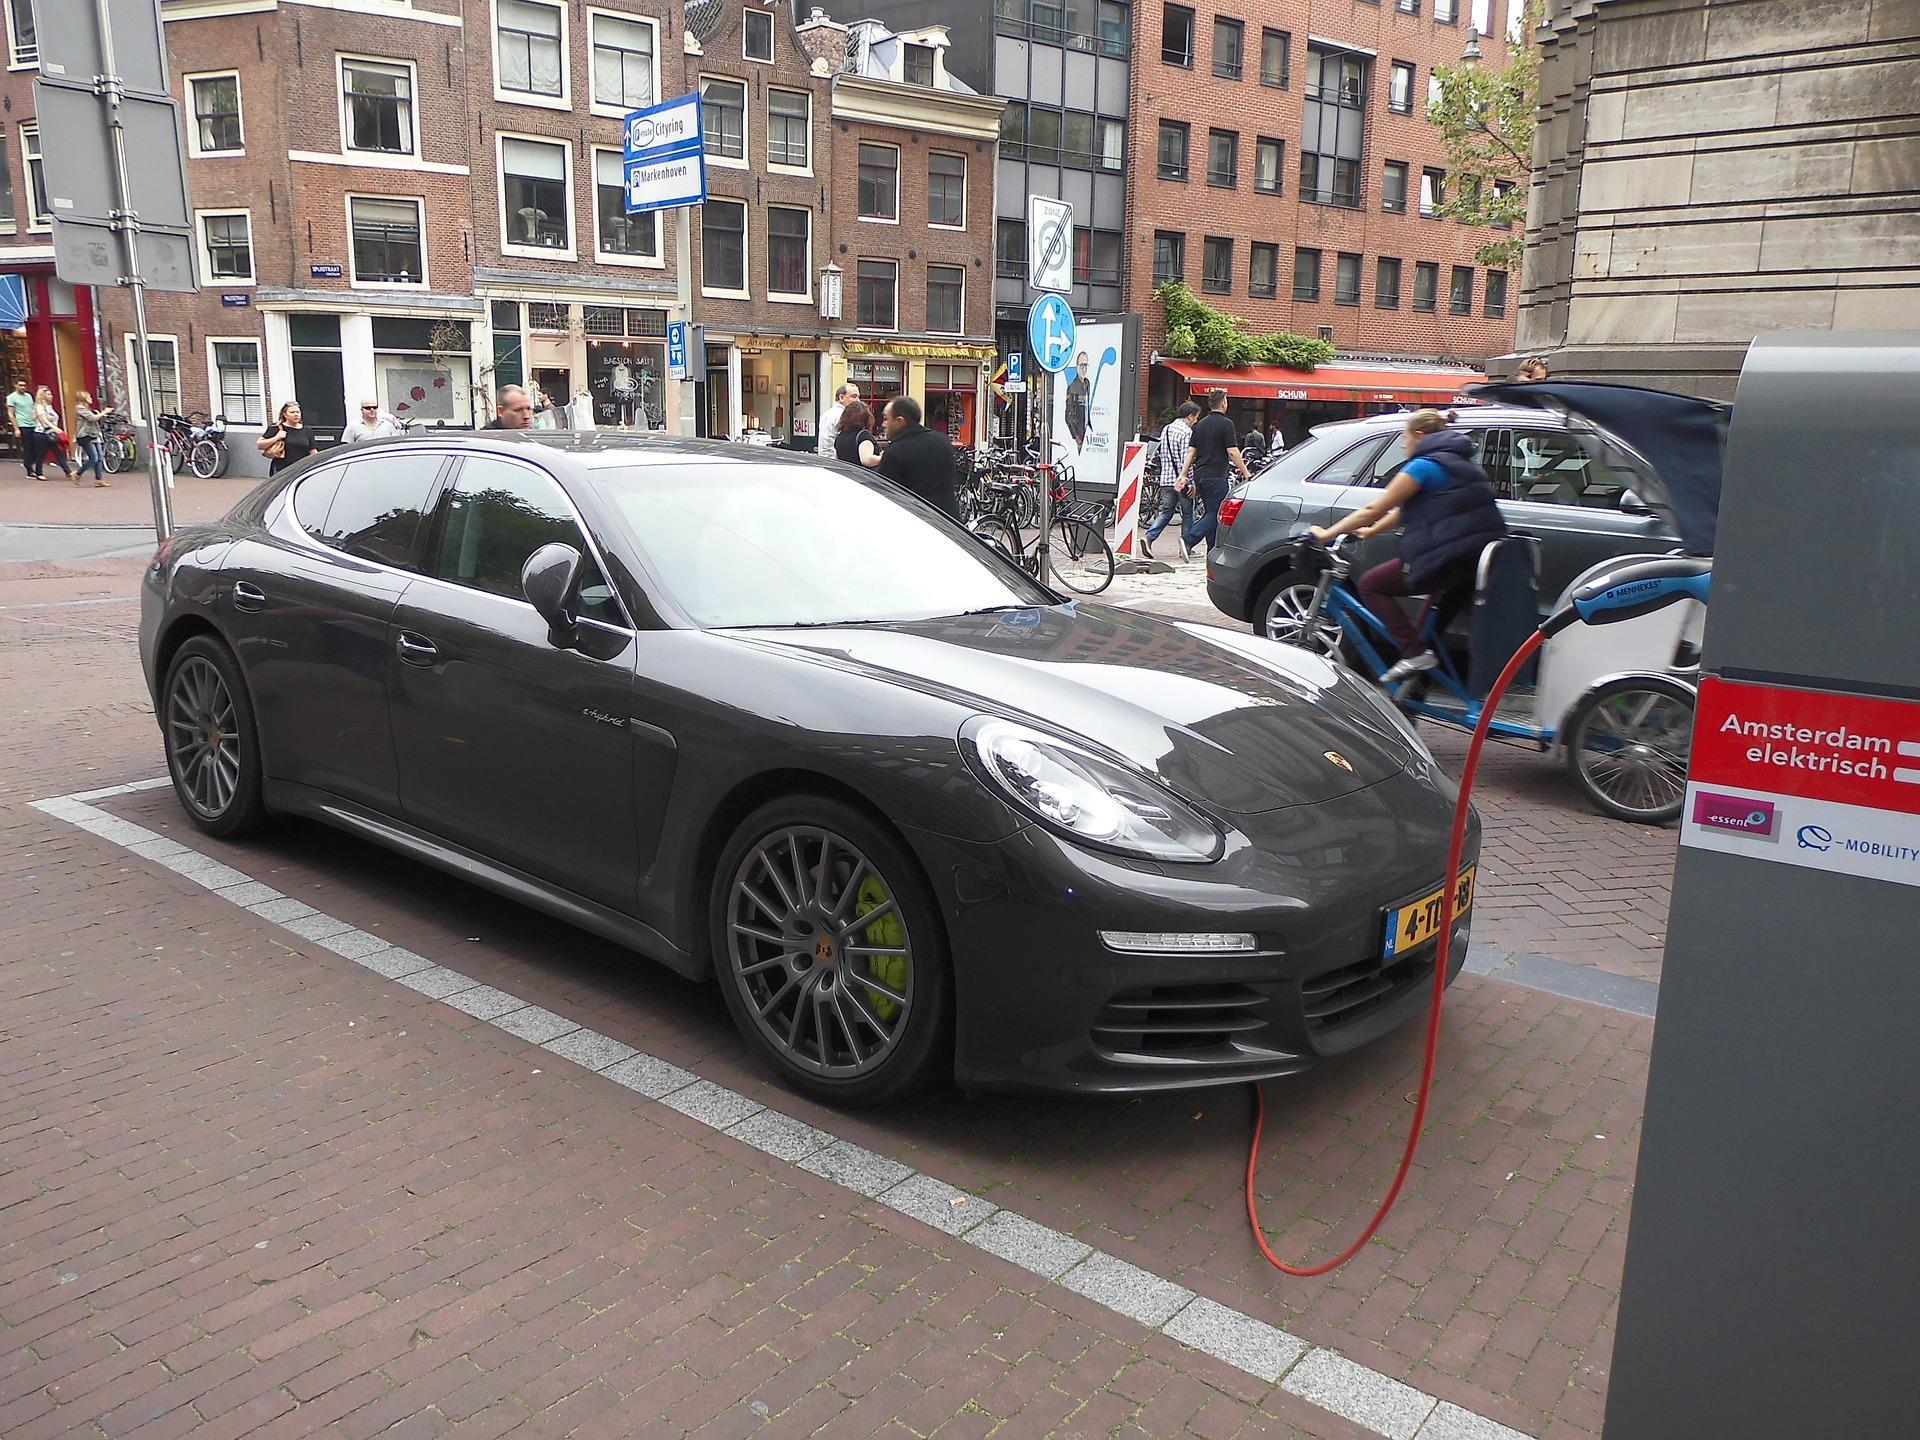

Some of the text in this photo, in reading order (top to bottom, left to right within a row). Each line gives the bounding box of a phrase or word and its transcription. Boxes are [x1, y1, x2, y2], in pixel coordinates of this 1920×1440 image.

[655, 118, 684, 138] Cityring
[641, 166, 687, 183] Markenhoven
[1277, 389, 1307, 400] SCHUIM
[794, 419, 808, 433] SALE
[1616, 580, 1658, 597] MENNEKES
[1720, 713, 1891, 753] Amsterdam
[1746, 743, 1887, 780] elektrisch
[1708, 814, 1748, 827] essent
